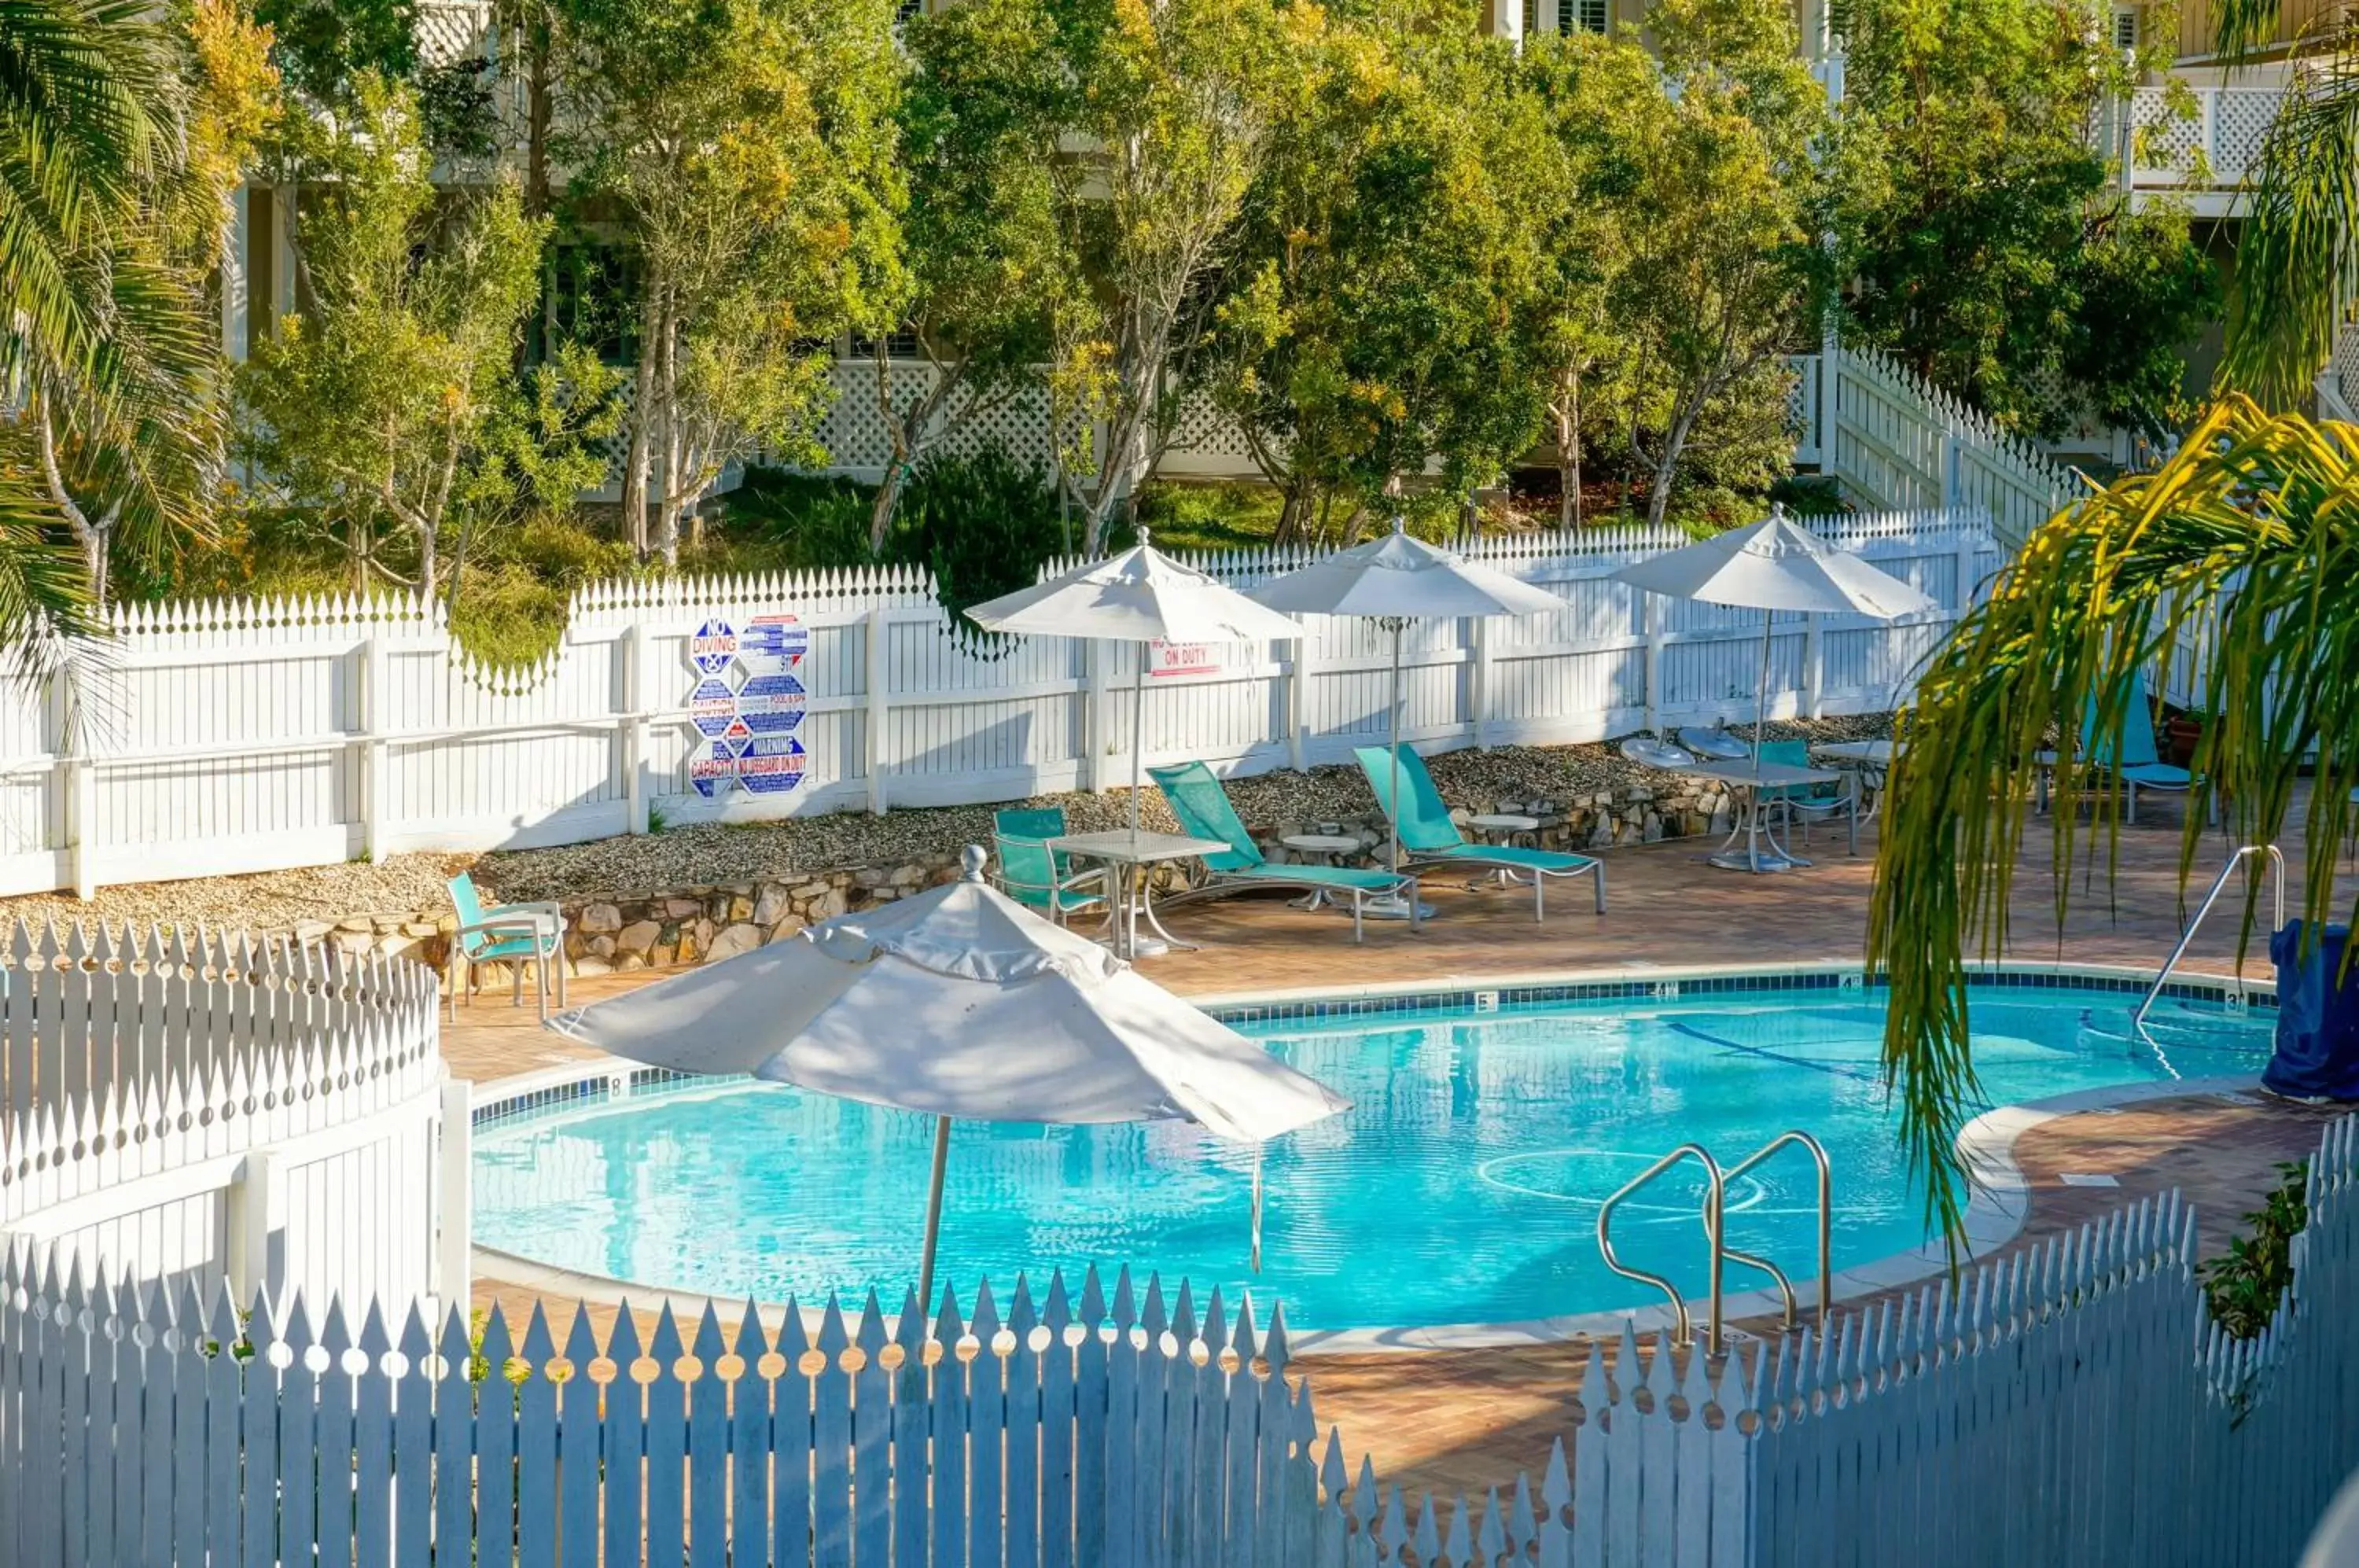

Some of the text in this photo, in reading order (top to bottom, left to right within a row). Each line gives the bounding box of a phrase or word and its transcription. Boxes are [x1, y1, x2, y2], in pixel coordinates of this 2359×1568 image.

[708, 619, 725, 635] NO
[693, 637, 736, 653] DIVING
[1165, 647, 1206, 665] ON DUTY
[692, 699, 734, 716] CAUTION
[753, 737, 793, 756] WARNING
[713, 751, 731, 760] POOL
[692, 759, 734, 778] CAPACITY
[739, 754, 807, 775] NO LIFEGUARD ON DUTY
[2228, 993, 2237, 1010] 3
[612, 1077, 620, 1096] 8
